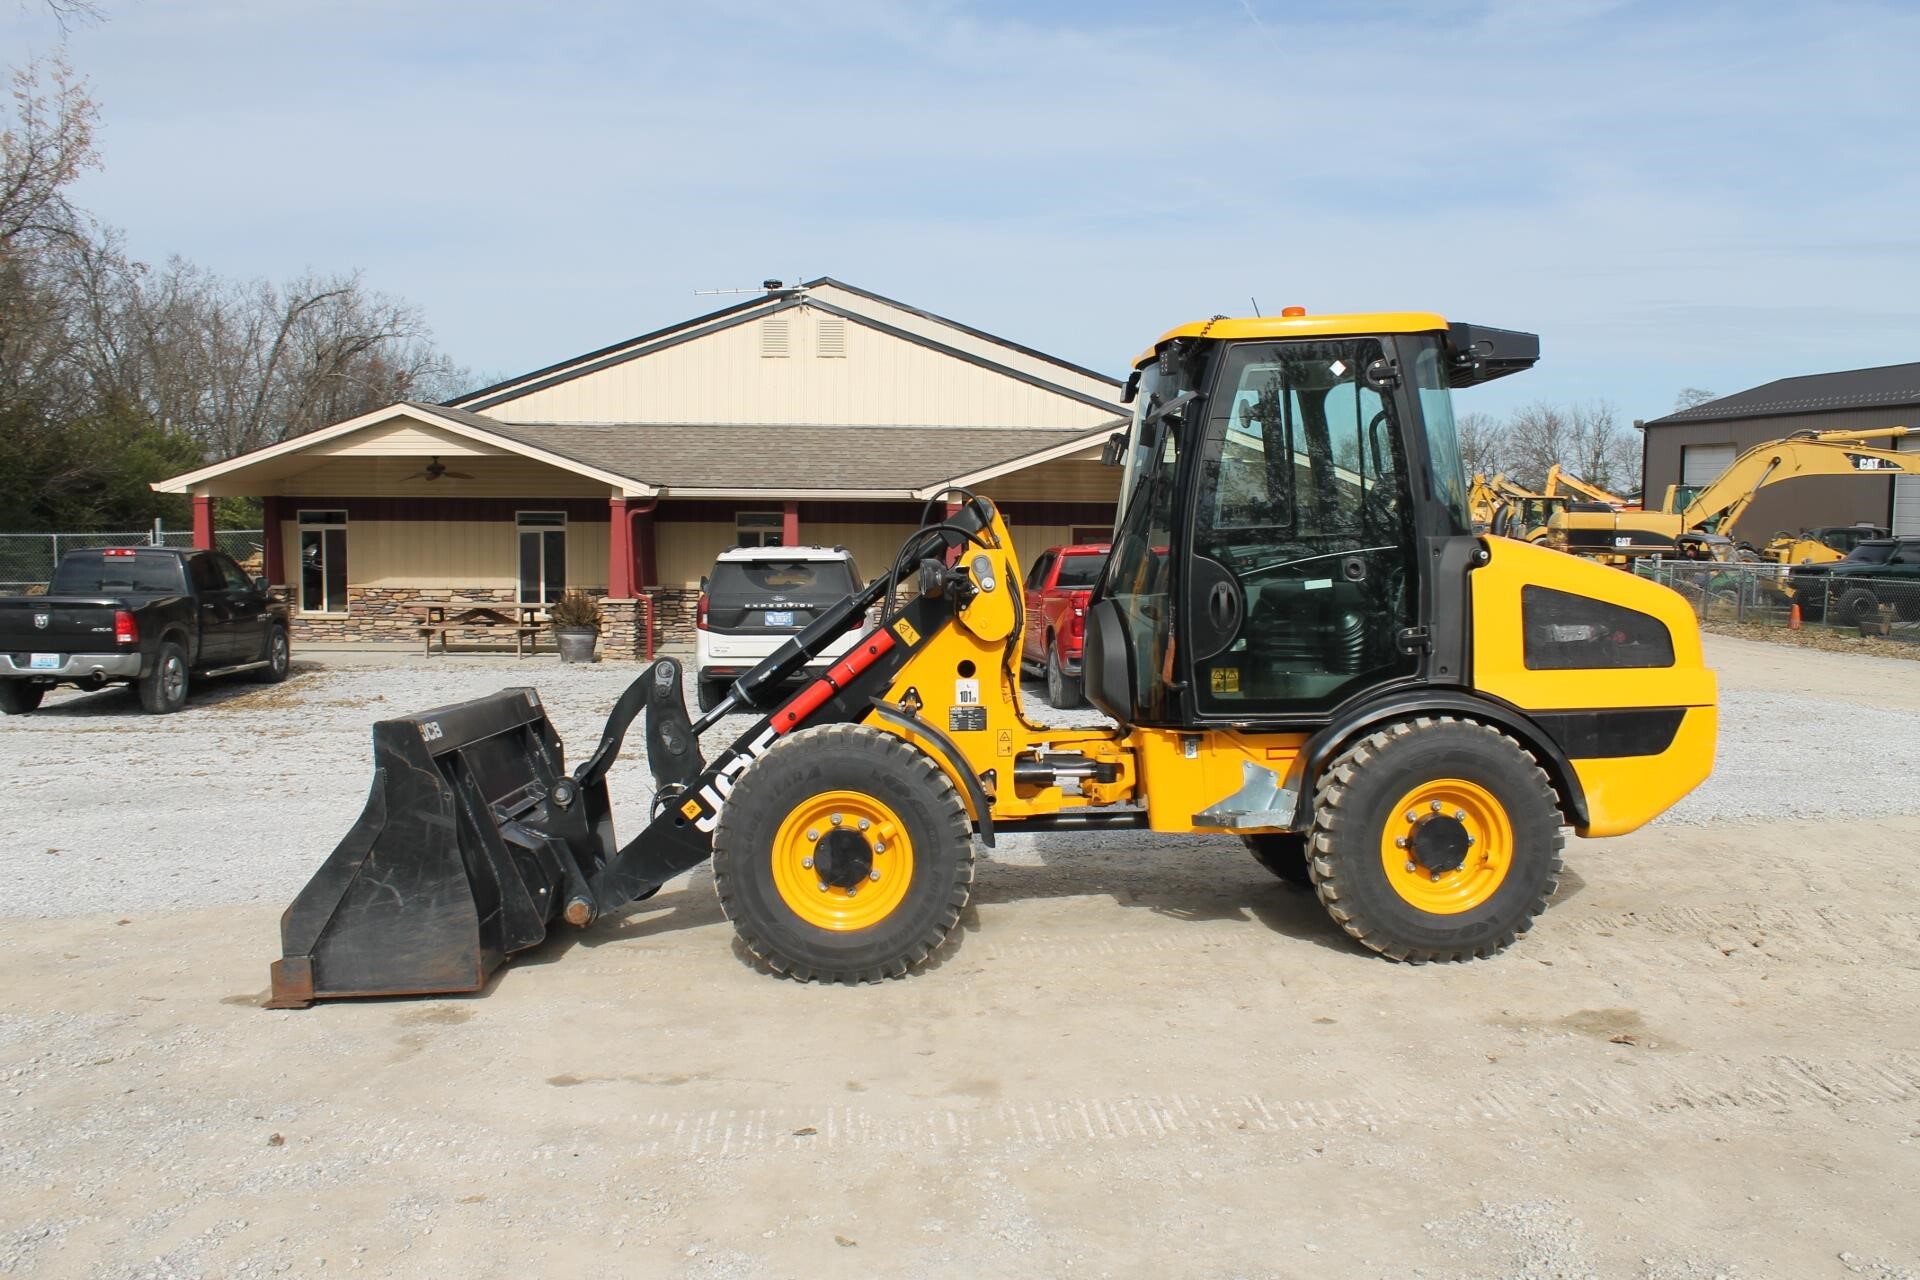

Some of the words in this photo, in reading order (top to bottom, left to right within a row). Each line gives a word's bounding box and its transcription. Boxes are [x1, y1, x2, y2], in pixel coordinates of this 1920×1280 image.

[1859, 458, 1880, 469] CAT
[1615, 536, 1632, 546] CAT
[960, 690, 972, 702] 101
[418, 721, 443, 741] JCB
